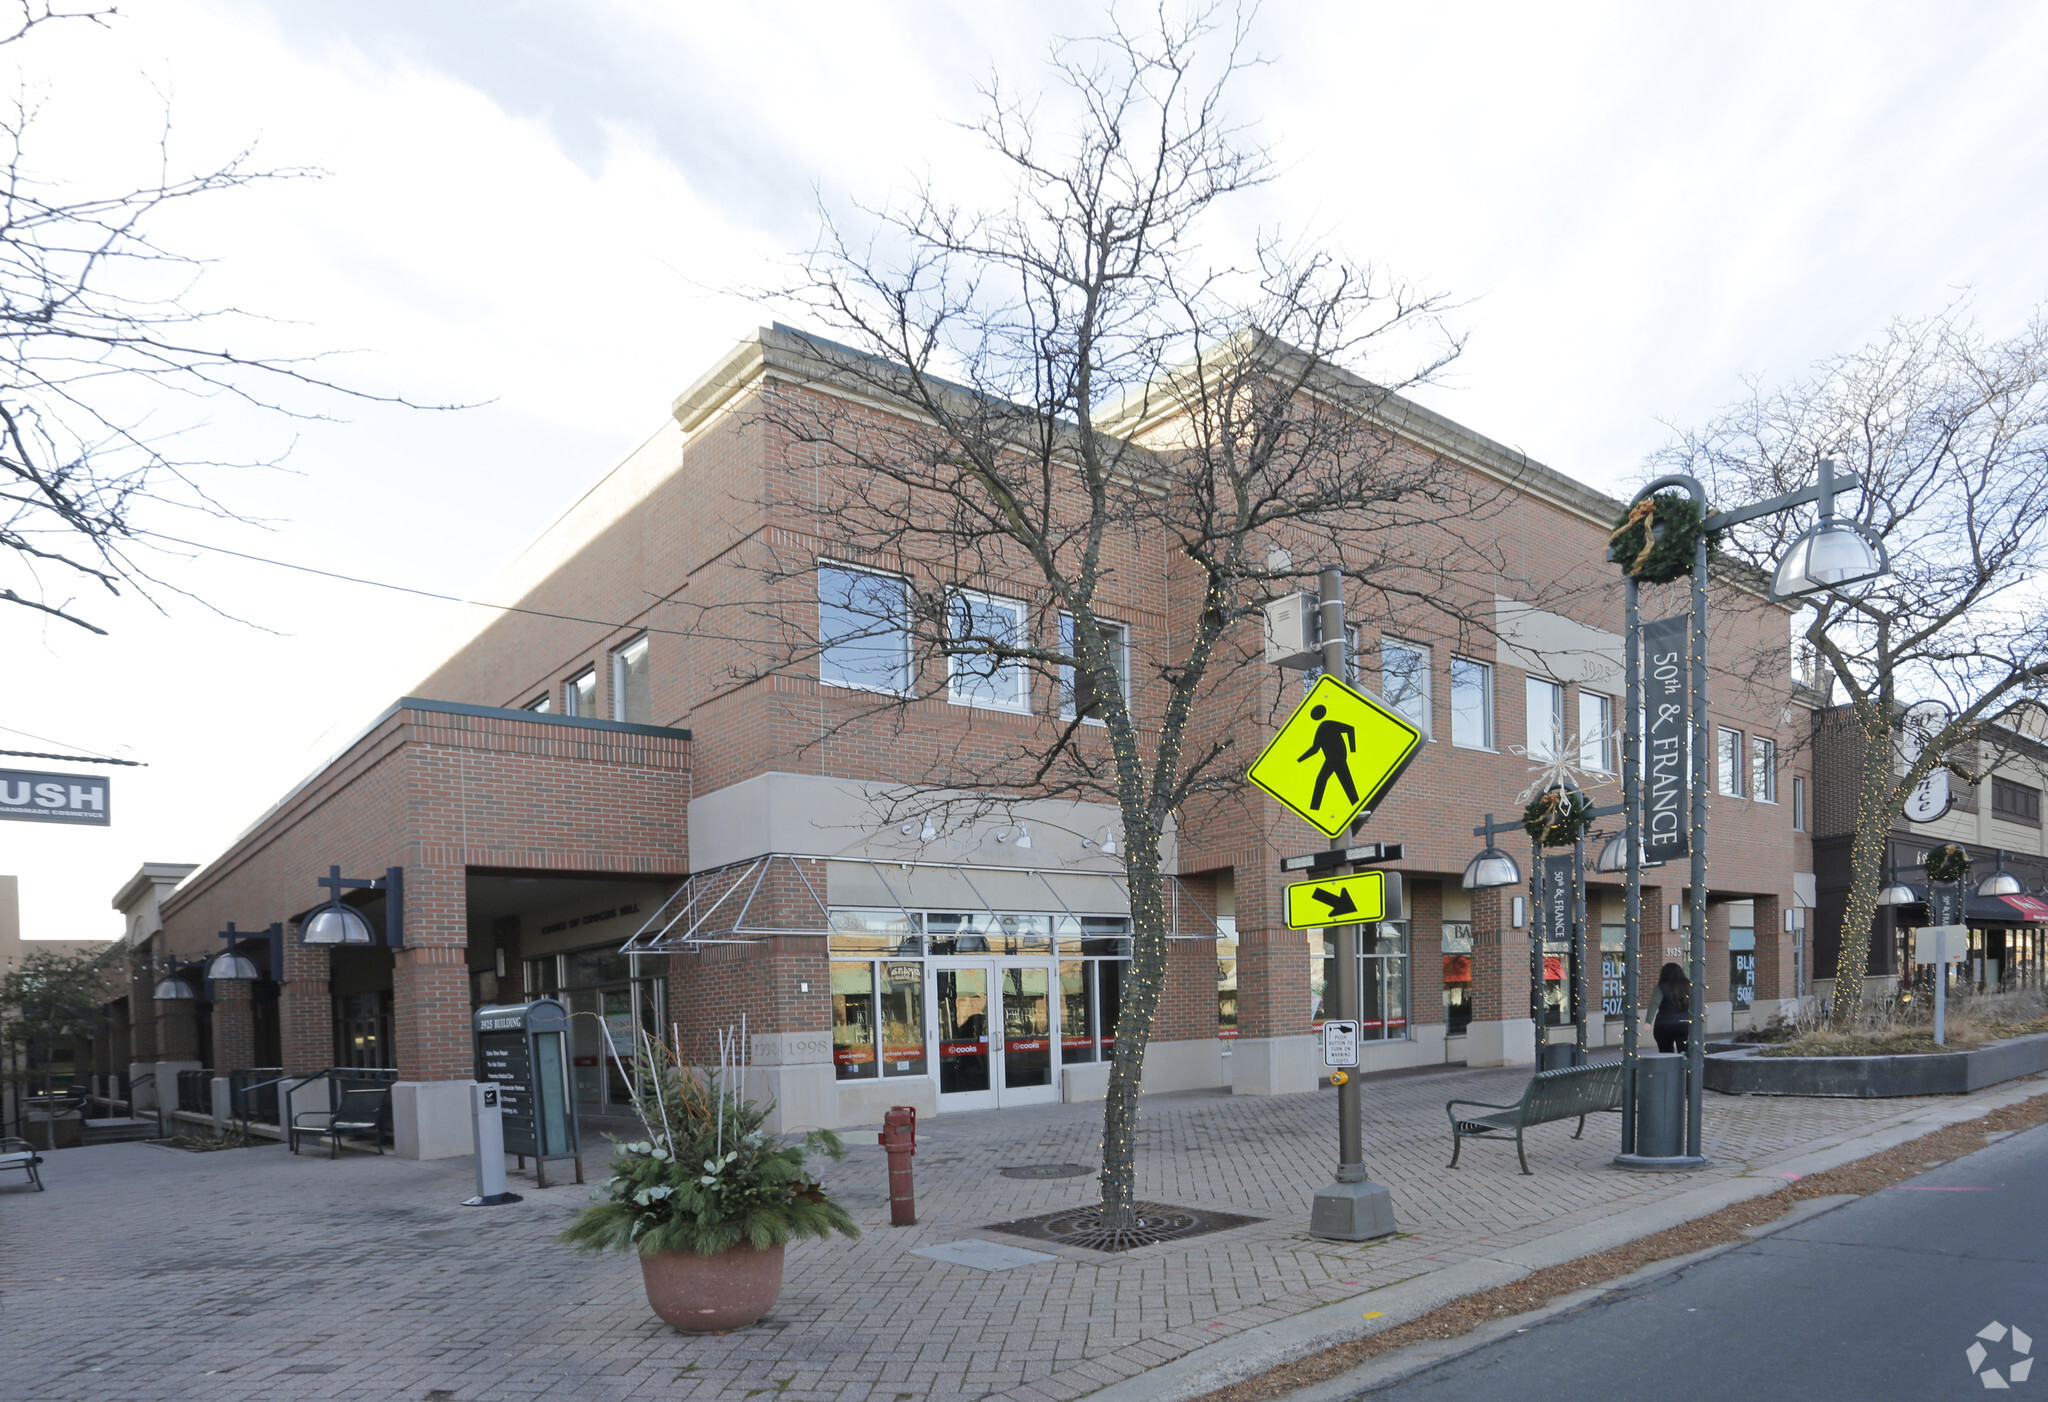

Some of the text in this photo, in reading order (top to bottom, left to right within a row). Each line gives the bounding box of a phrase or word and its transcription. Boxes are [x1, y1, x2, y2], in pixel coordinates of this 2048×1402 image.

[1651, 652, 1682, 846] 50th & FRANCE
[51, 809, 104, 818] COSMETICS
[1553, 888, 1565, 900] &
[1554, 900, 1565, 938] FRANCE
[493, 1016, 521, 1029] BUILDING
[789, 1039, 828, 1056] 1998
[955, 1046, 978, 1054] cooks
[1019, 1042, 1040, 1050] cooks
